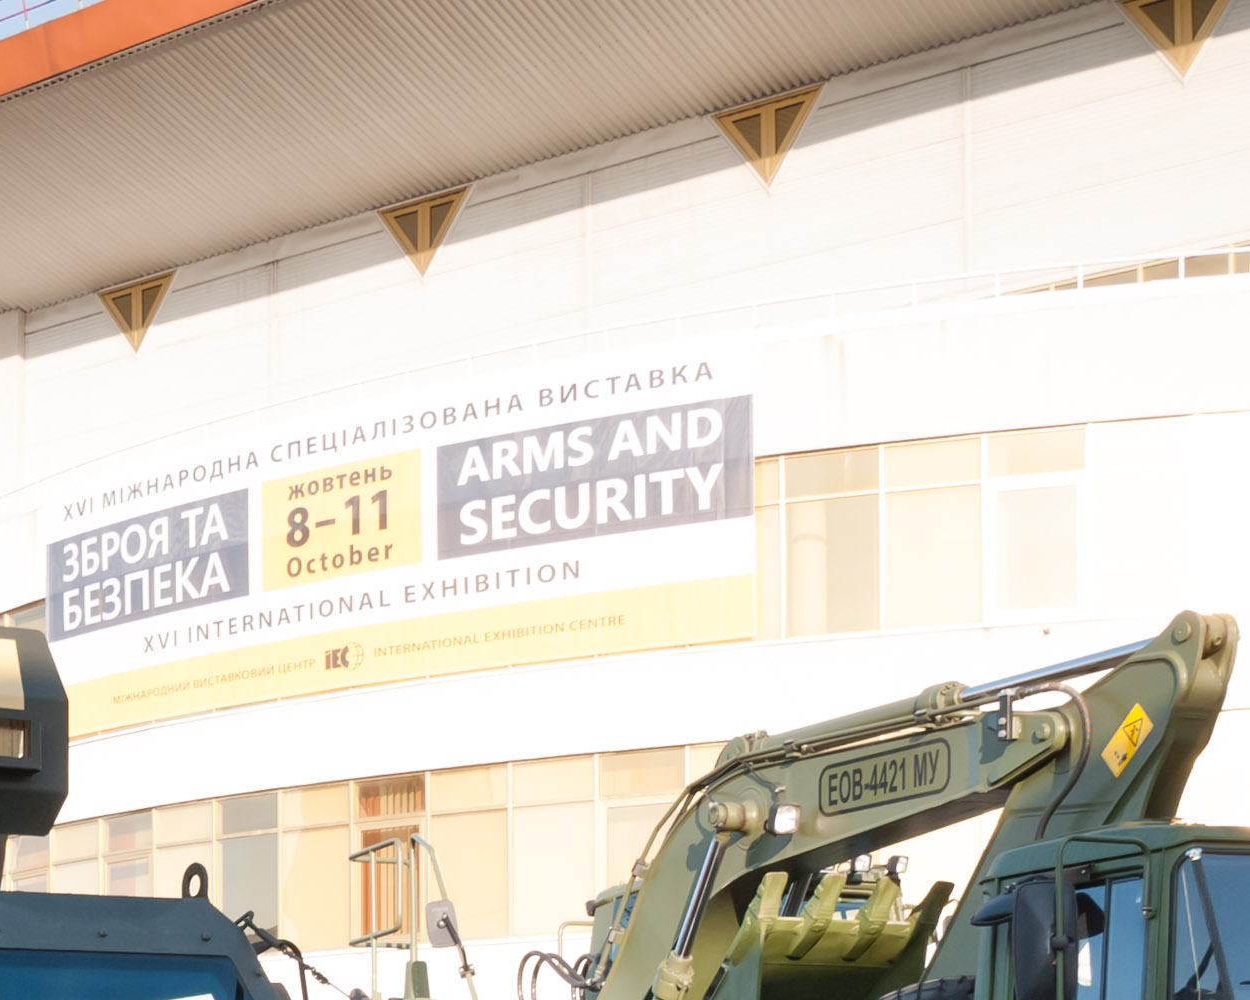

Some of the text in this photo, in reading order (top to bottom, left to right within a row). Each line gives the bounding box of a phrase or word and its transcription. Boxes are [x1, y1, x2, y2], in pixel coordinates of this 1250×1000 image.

[63, 361, 714, 521] XVI МІЖНАРОДНА СПЕЦІАЛІЗОВАНА ВИСТАВКА
[457, 406, 724, 487] ARMS AND
[62, 503, 230, 584] ЗБРОЯ ТА
[459, 462, 725, 546] SECURITY
[62, 551, 231, 633] БЕЗПЕКА
[287, 542, 394, 579] October
[144, 559, 582, 654] XVI INTERNATIONAL EXHIBITION
[373, 614, 627, 658] INTERNATIONAL EXHIBITION CENTRE
[112, 658, 316, 705] МІЖНАРОДНИЙ ВИСТАВКОВИЙ ЦЕНТР
